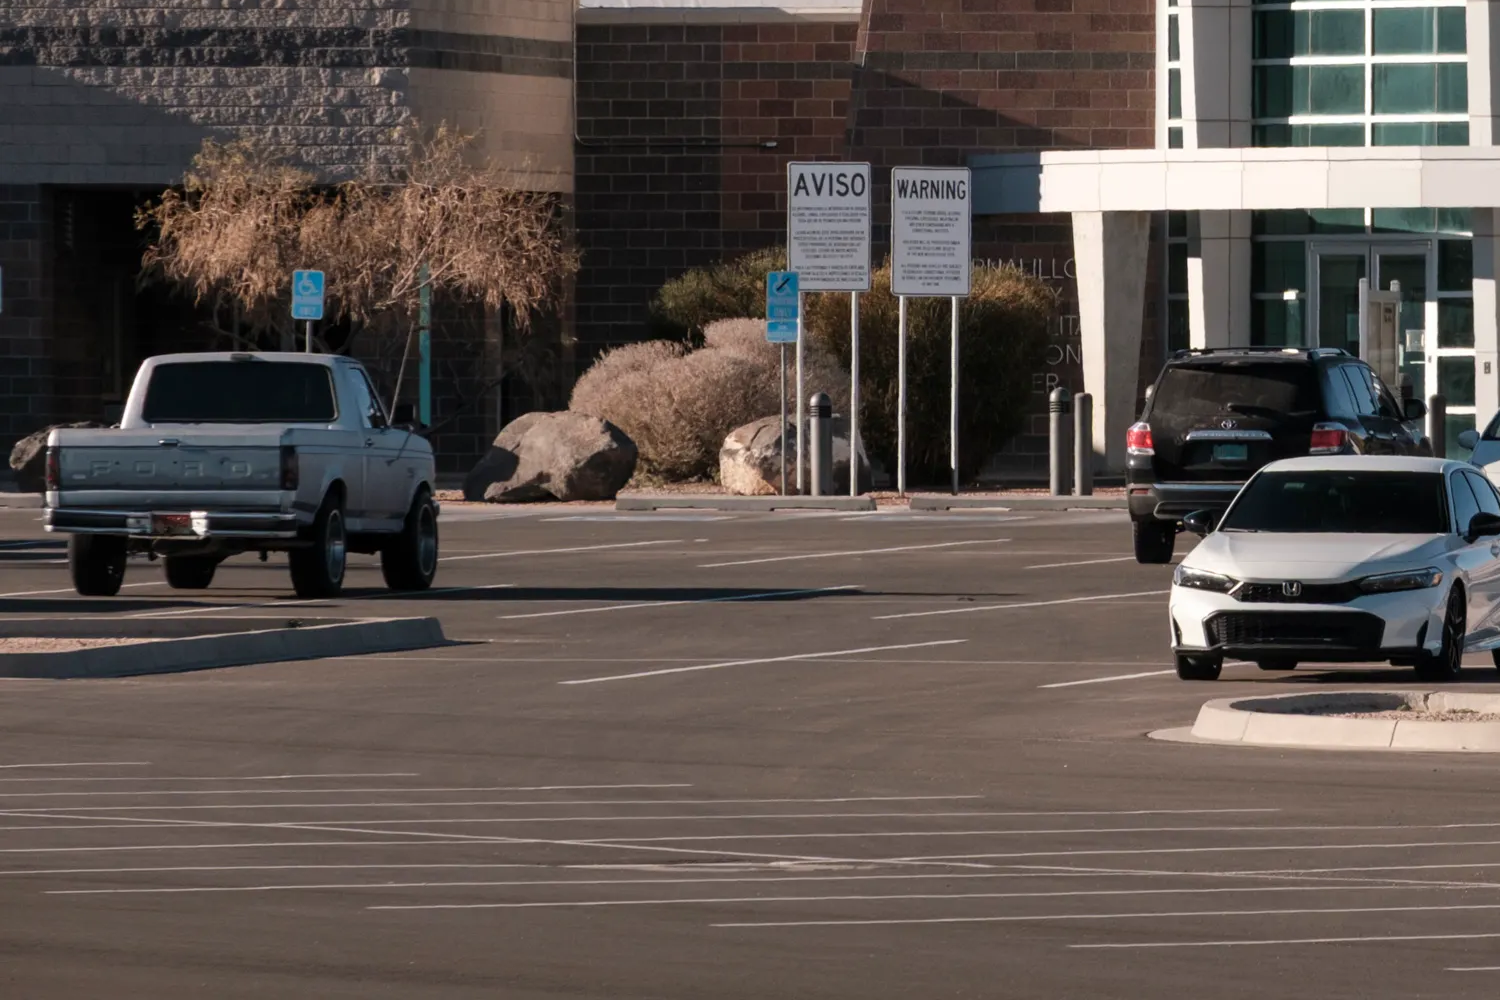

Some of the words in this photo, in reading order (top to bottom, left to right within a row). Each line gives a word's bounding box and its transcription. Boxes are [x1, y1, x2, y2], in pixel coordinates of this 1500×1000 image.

[793, 173, 866, 197] AVISO
[897, 179, 967, 200] WARNING
[90, 460, 252, 478] FORD
